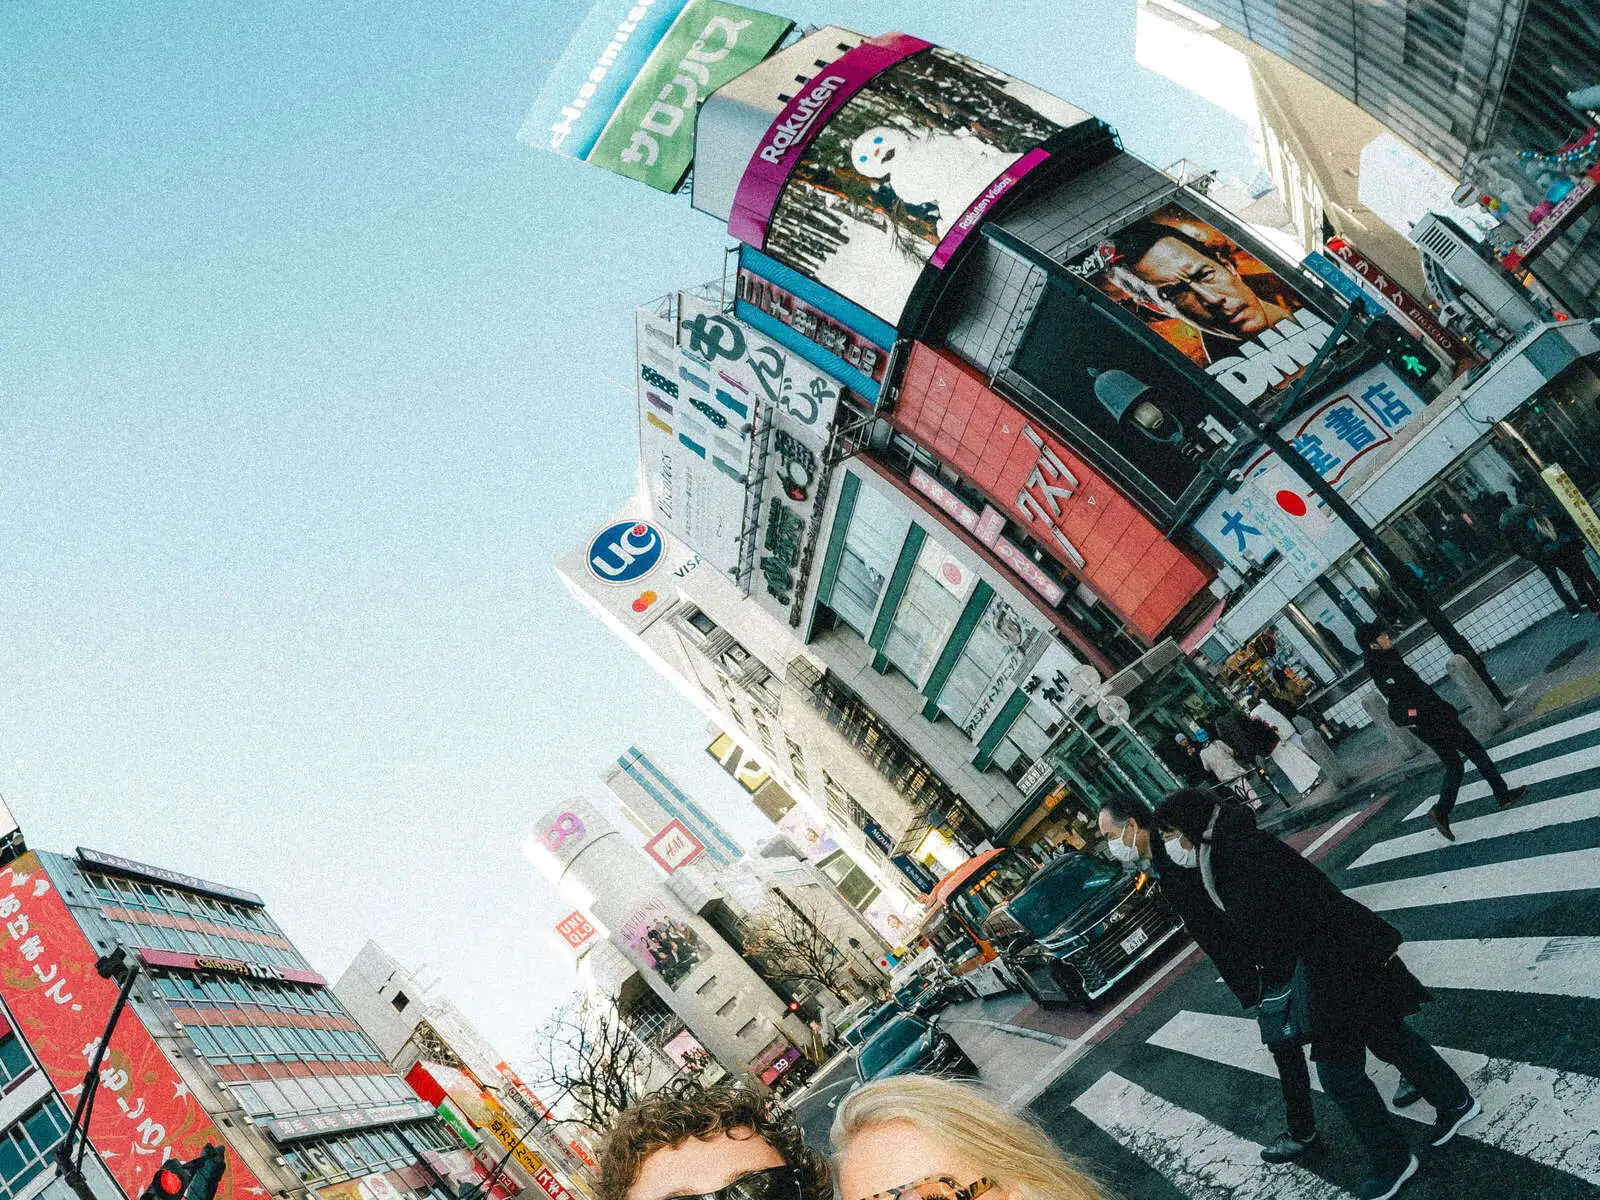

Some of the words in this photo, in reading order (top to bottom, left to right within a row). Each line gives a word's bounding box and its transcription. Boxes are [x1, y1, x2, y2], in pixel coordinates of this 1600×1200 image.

[620, 14, 753, 168] サロンパス
[760, 74, 847, 165] Rakuten
[957, 195, 991, 231] Rakuten
[984, 176, 1012, 205] Vision
[1336, 242, 1406, 306] カラオケ
[738, 274, 881, 380] 三千里薬品
[680, 312, 837, 425] もんじゃ
[1016, 424, 1087, 568] クスリ
[592, 526, 657, 578] UC
[559, 914, 584, 935] UNI
[569, 922, 594, 948] QLO
